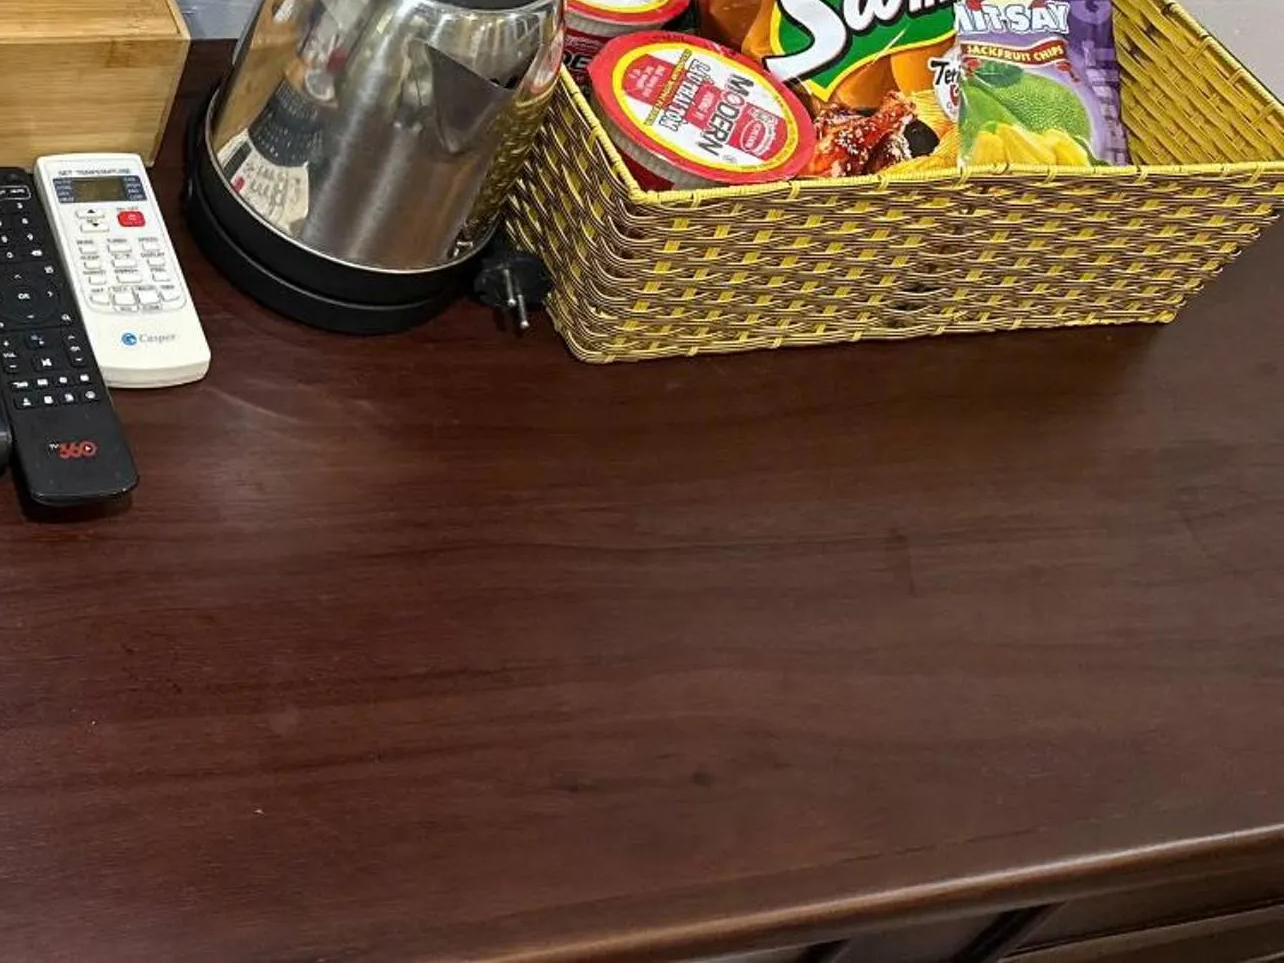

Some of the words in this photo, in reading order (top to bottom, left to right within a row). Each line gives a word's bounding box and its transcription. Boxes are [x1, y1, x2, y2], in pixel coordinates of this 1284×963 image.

[967, 44, 1031, 63] JACKFRUIT
[1033, 44, 1064, 63] CHIPS
[698, 73, 754, 156] MODERN
[140, 333, 177, 343] Casper
